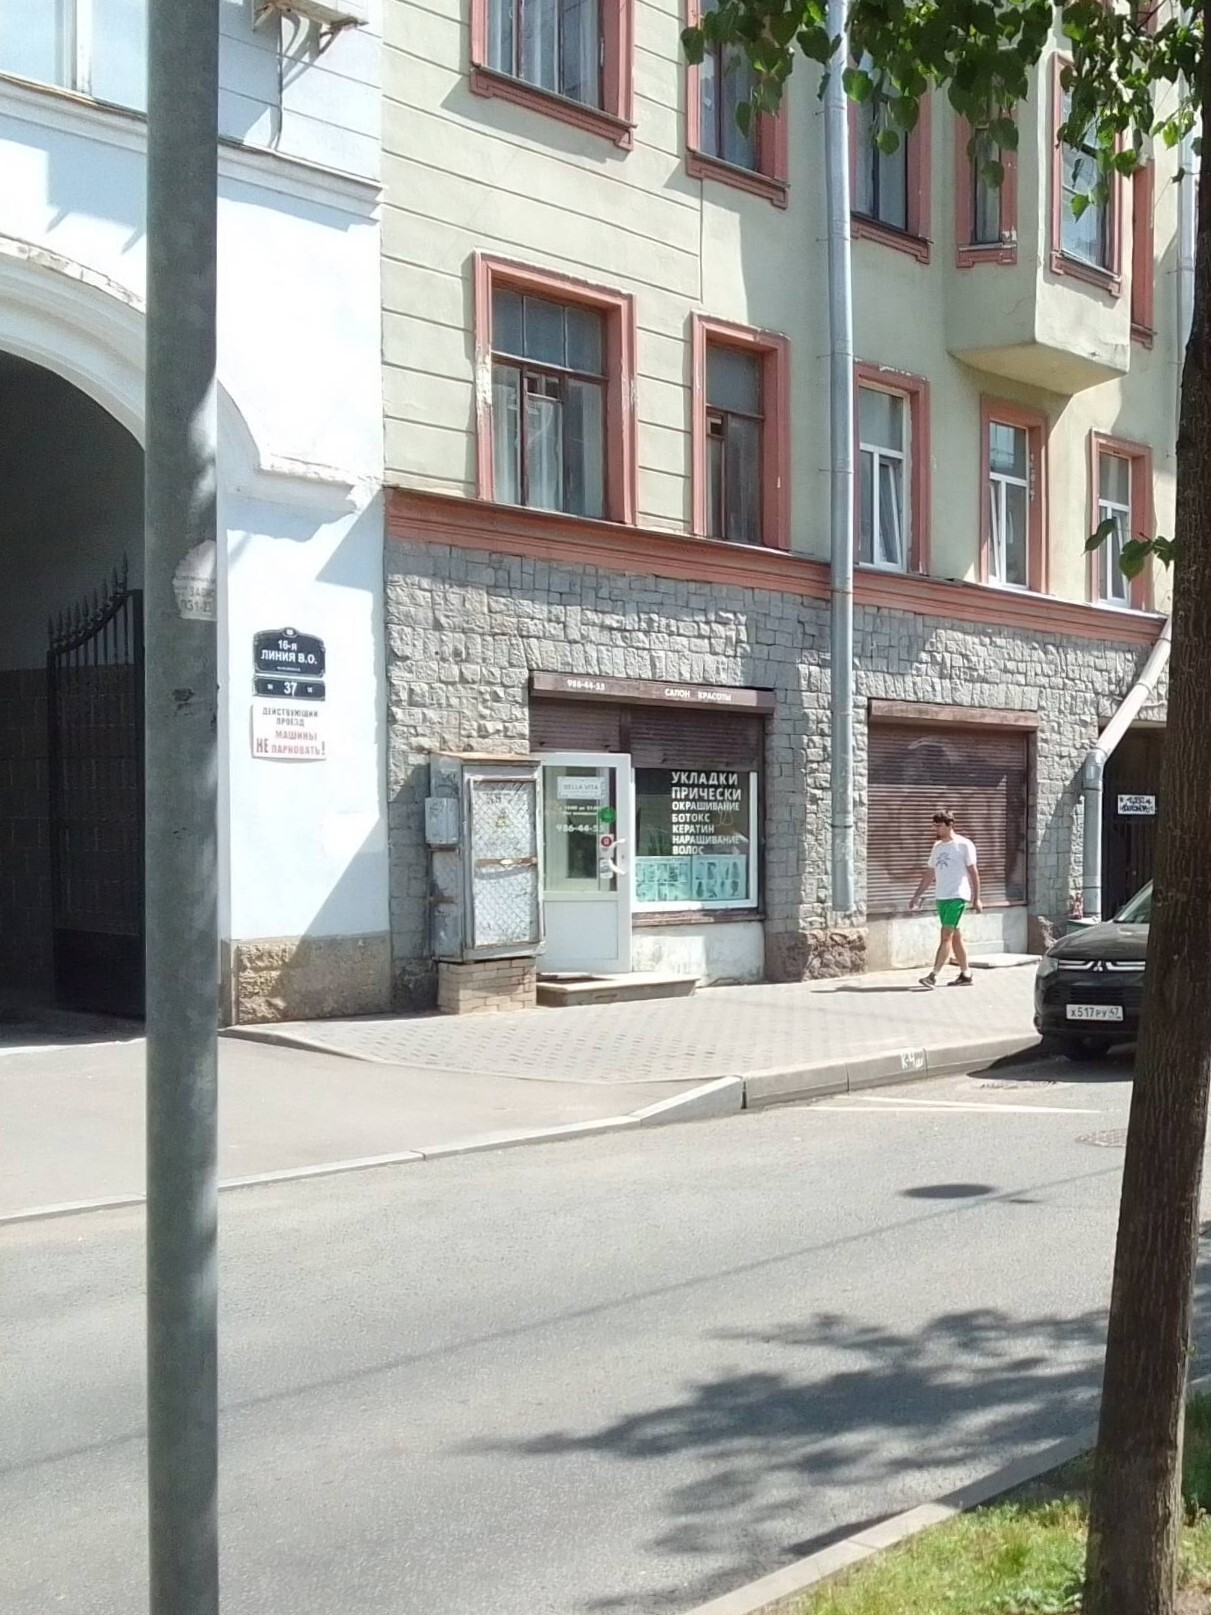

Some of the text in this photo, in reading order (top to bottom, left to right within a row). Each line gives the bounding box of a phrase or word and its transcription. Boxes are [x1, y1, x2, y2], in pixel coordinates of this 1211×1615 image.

[278, 640, 297, 651] 16-я
[261, 650, 317, 665] ЛИНИЯ В.О.
[284, 681, 298, 697] 37
[665, 688, 732, 702] САЛОН КРАСОТЫ
[262, 707, 318, 718] ДЕЙСТВУЮЩИЙ
[276, 717, 305, 727] ПРОЕЗД
[275, 730, 317, 741] МАШИНЫ
[256, 738, 269, 753] НЕ
[671, 771, 738, 785] УКЛАДКИ
[671, 787, 742, 801] ПРИЧЕСКИ
[671, 801, 740, 811] ОКРАШИВАНИЕ
[671, 813, 711, 822] БОТОКС
[672, 824, 715, 834] КЕРАТИН
[672, 845, 704, 855] ВОЛОС
